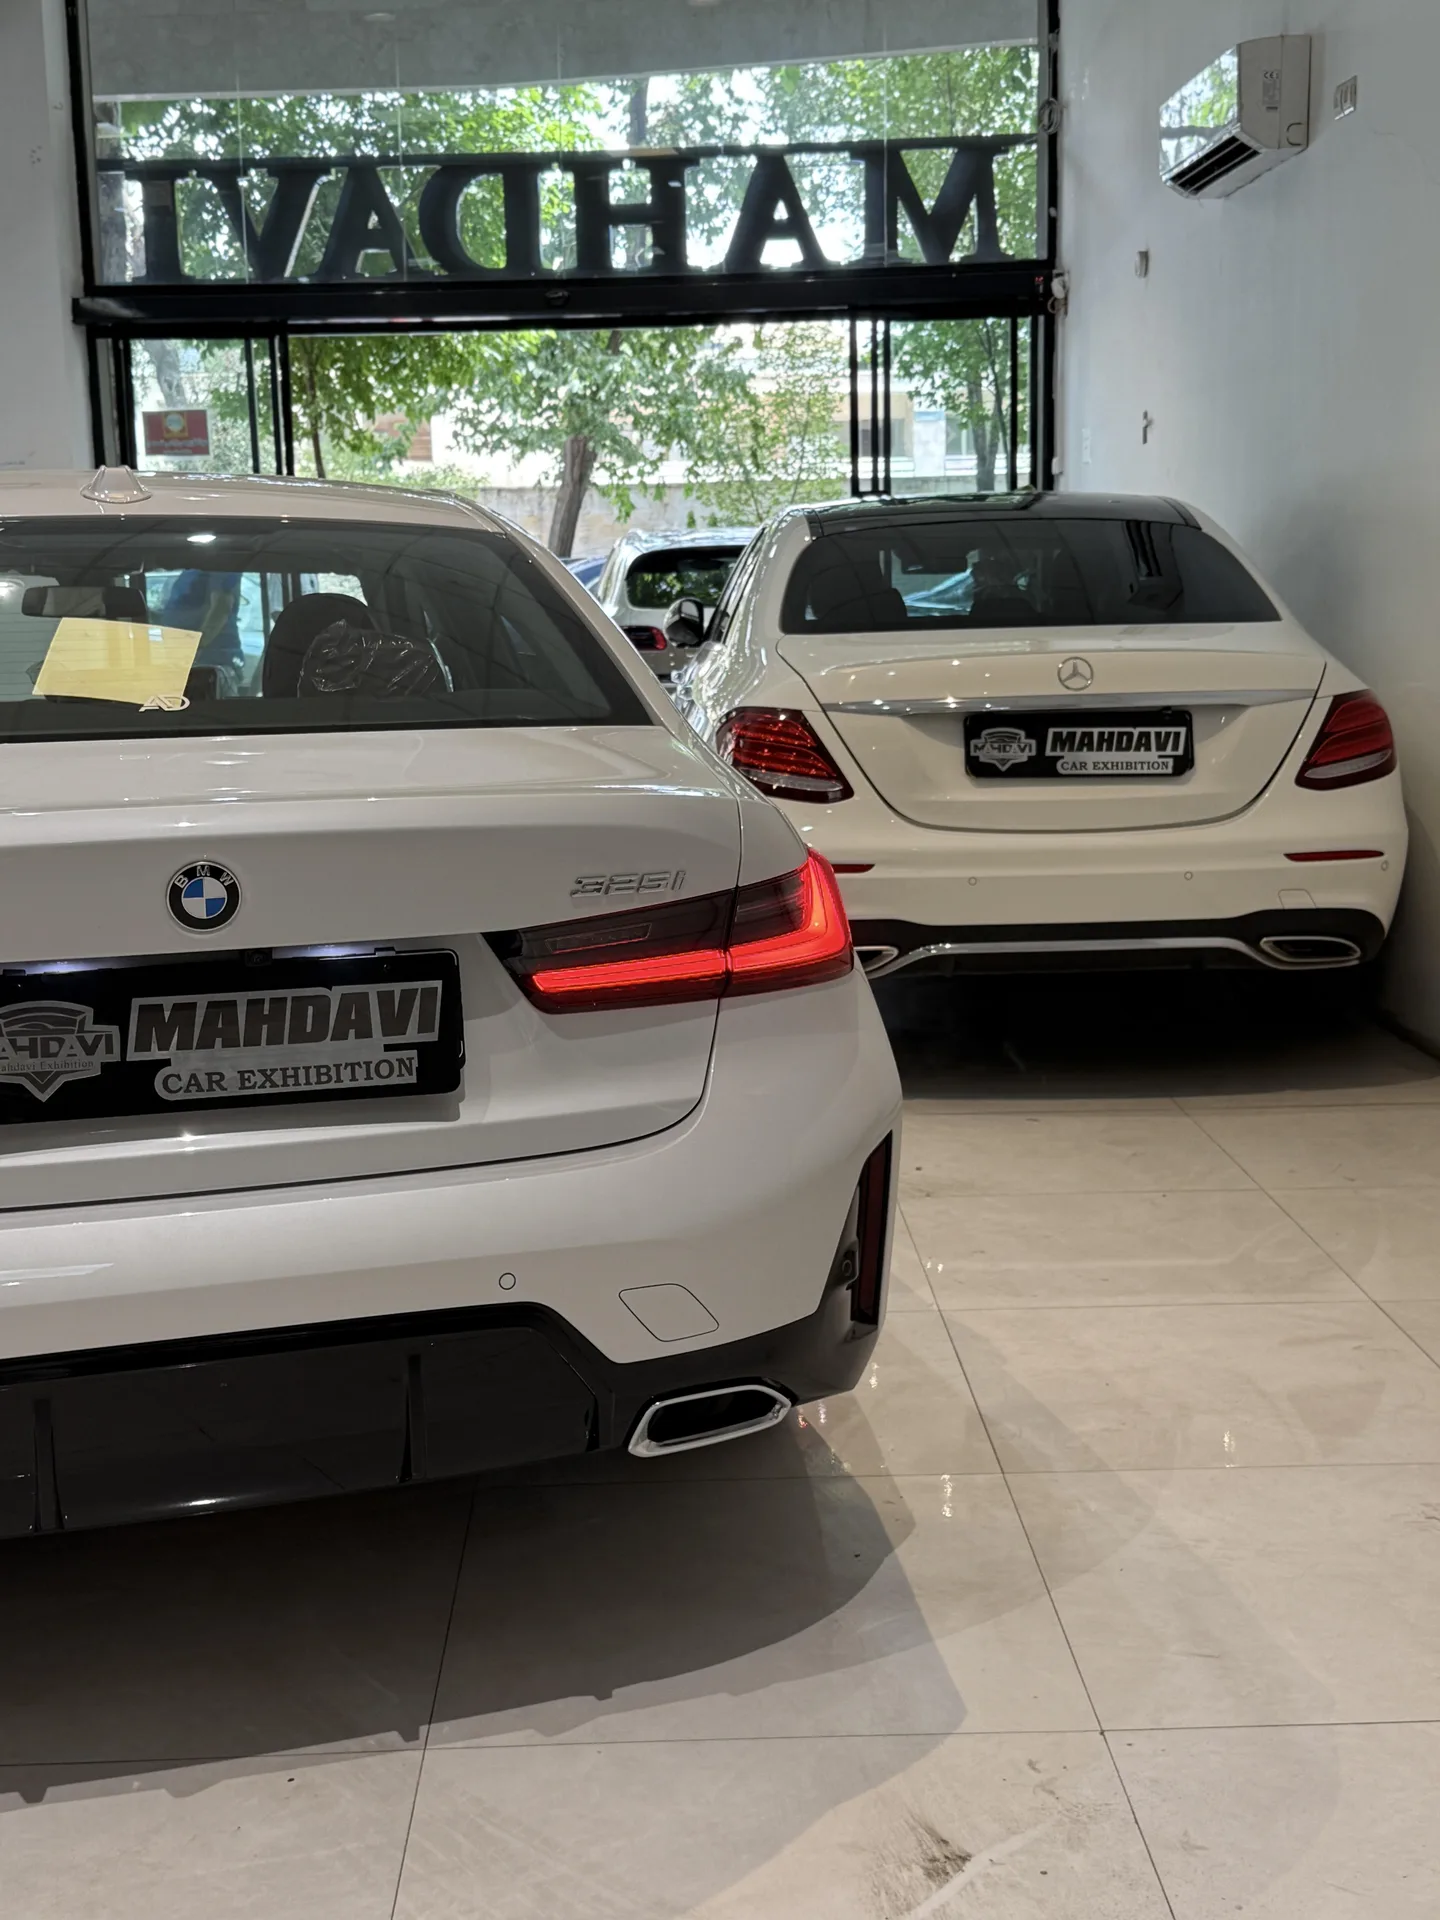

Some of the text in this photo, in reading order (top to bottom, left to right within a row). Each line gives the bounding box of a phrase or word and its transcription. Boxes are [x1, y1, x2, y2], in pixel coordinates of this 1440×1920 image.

[1049, 730, 1182, 752] MAHDAVI
[1060, 761, 1169, 771] CAR EXHIBITION
[174, 865, 234, 888] BMW
[134, 986, 438, 1053] MAHDAVI
[0, 1033, 114, 1060] AHDAVI
[40, 1060, 94, 1071] Exhibition
[162, 1056, 415, 1094] CAR EXHIBITION
